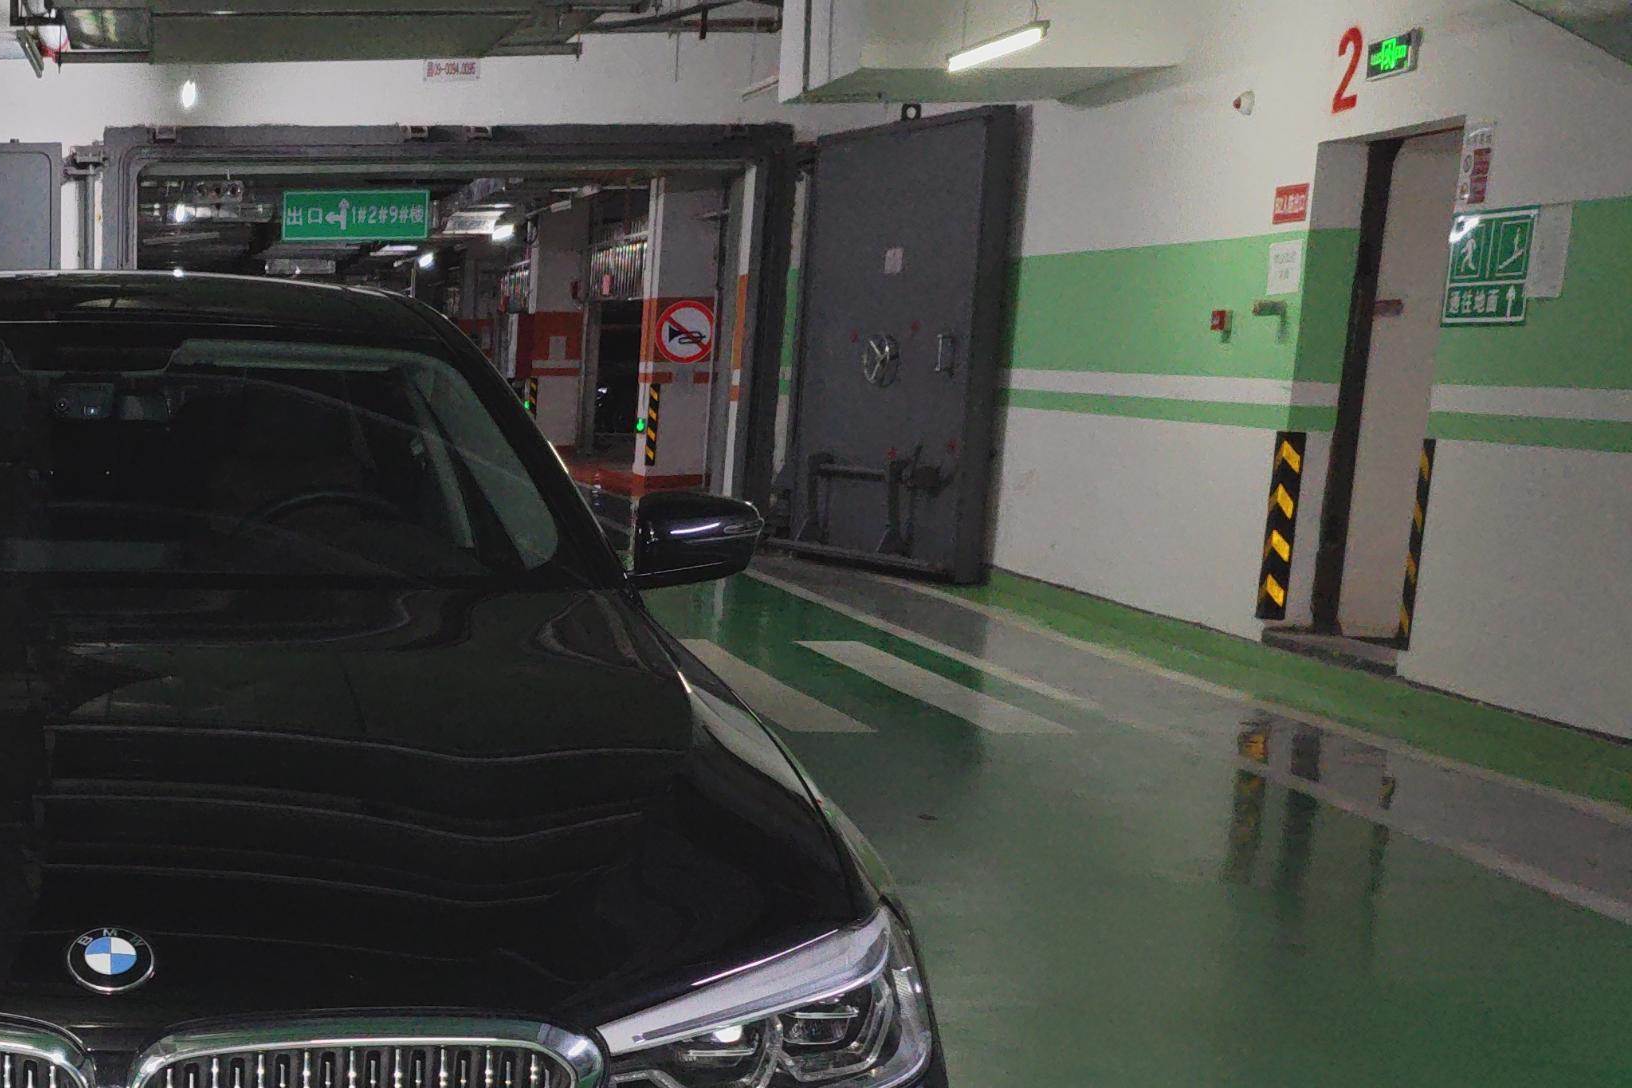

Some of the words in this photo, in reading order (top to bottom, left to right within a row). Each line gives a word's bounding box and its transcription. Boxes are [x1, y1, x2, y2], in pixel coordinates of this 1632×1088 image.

[1331, 27, 1363, 114] 2
[286, 206, 323, 226] 出口
[1448, 287, 1500, 315] 通往地面
[78, 929, 144, 946] BMW
